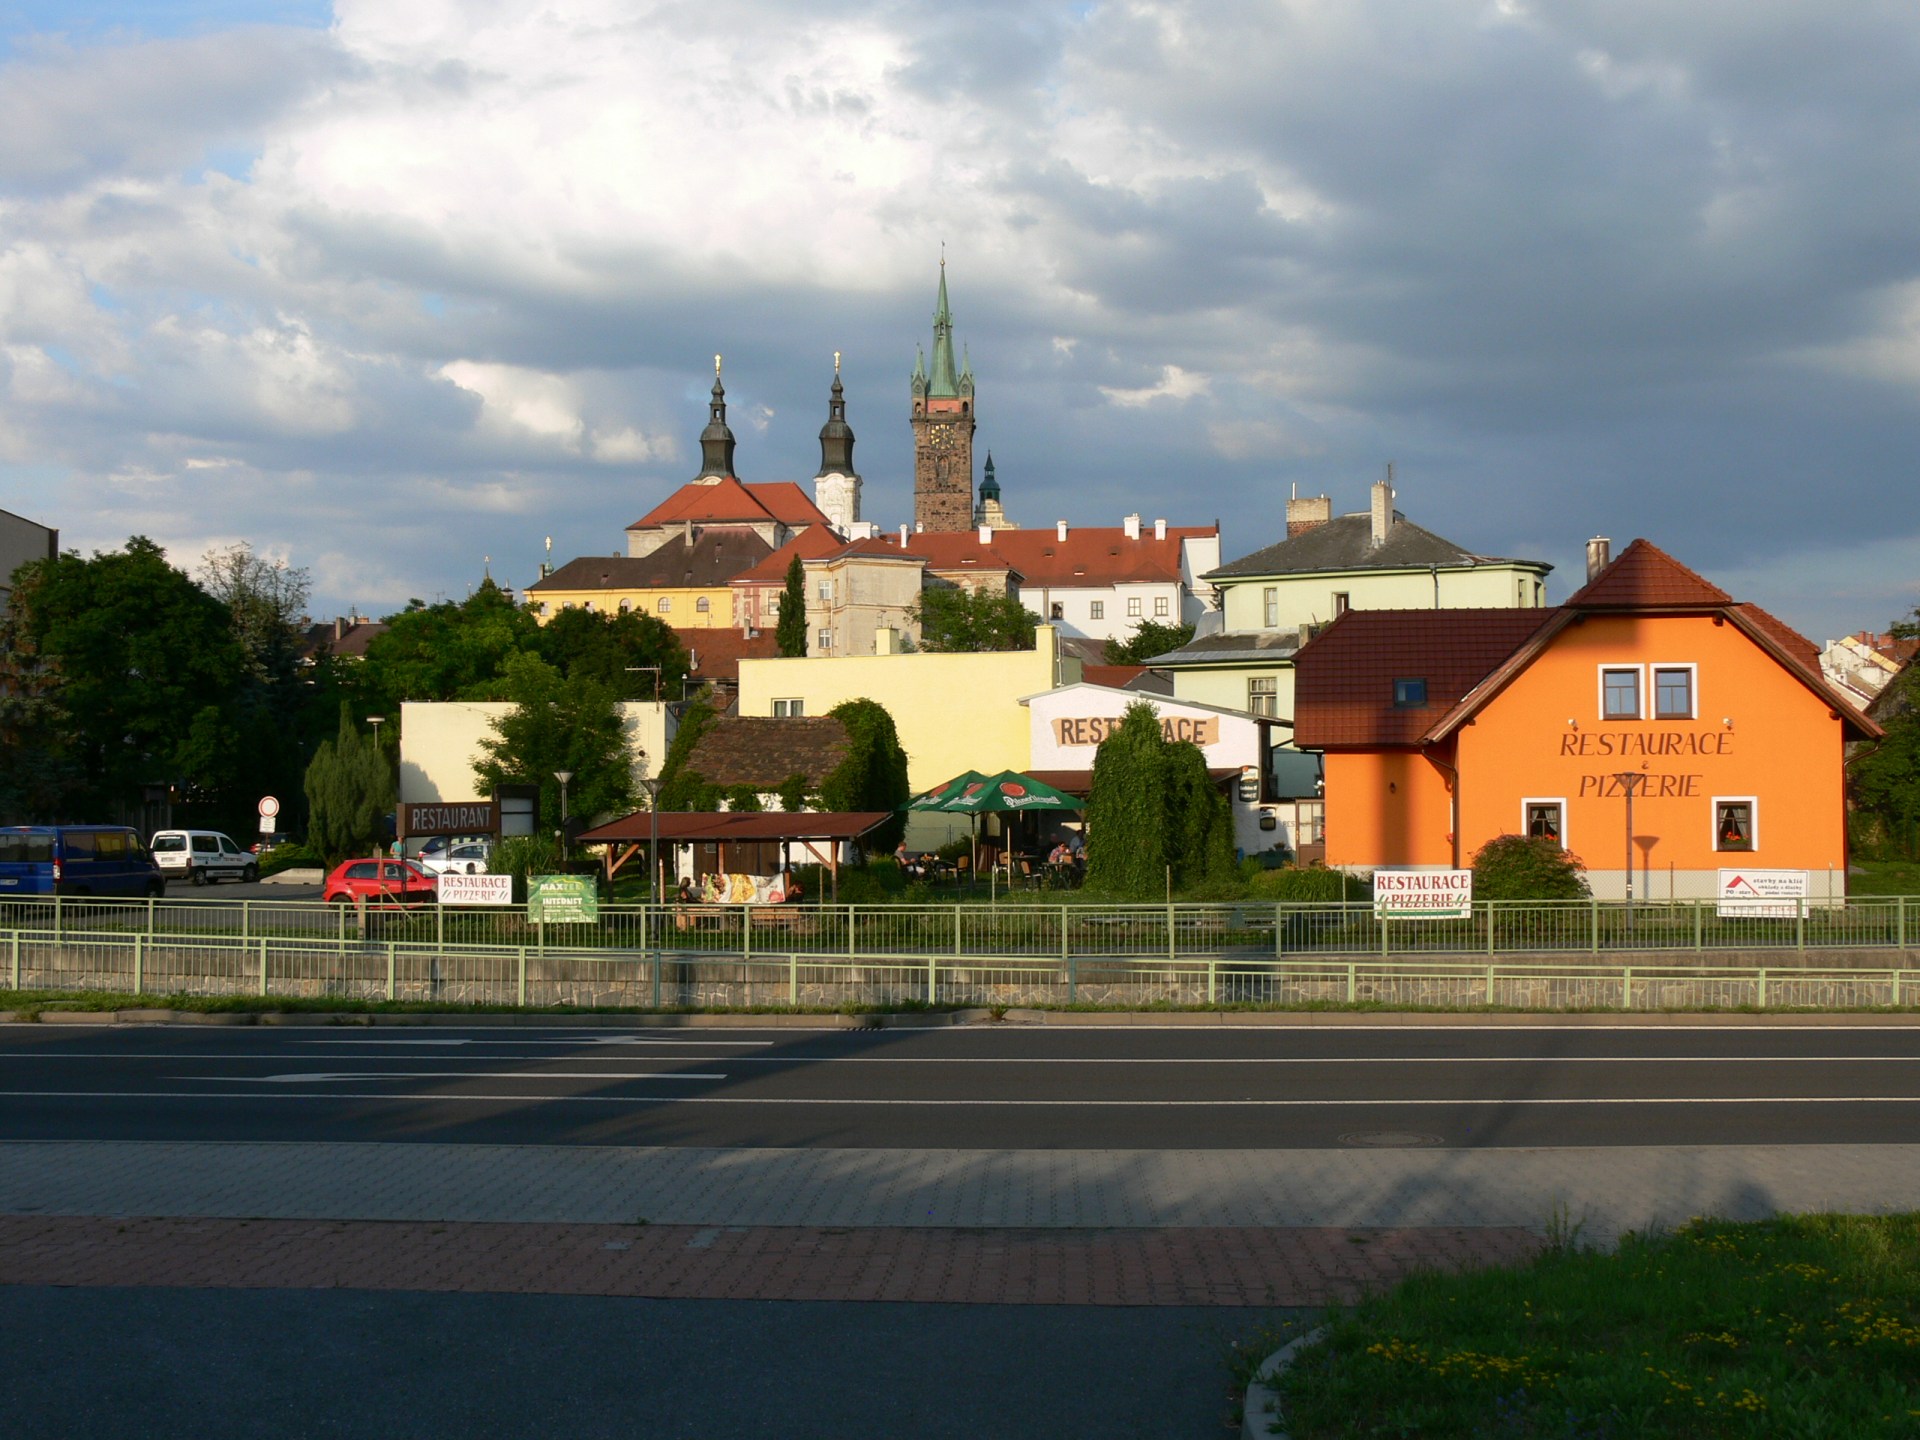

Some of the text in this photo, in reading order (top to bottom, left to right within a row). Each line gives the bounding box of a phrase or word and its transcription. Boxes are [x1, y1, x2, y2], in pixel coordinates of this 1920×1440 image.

[1061, 717, 1206, 745] RESTACE
[1560, 732, 1734, 756] RESTAURACE
[1578, 774, 1703, 798] PIZERIE
[412, 806, 491, 831] RESTAURANT
[443, 877, 508, 888] RESTAURACE
[1377, 875, 1468, 890] RESTAURACE
[453, 889, 496, 901] PIZZERIE
[543, 897, 583, 905] INTERNET
[1391, 893, 1454, 908] PIZZERIE
